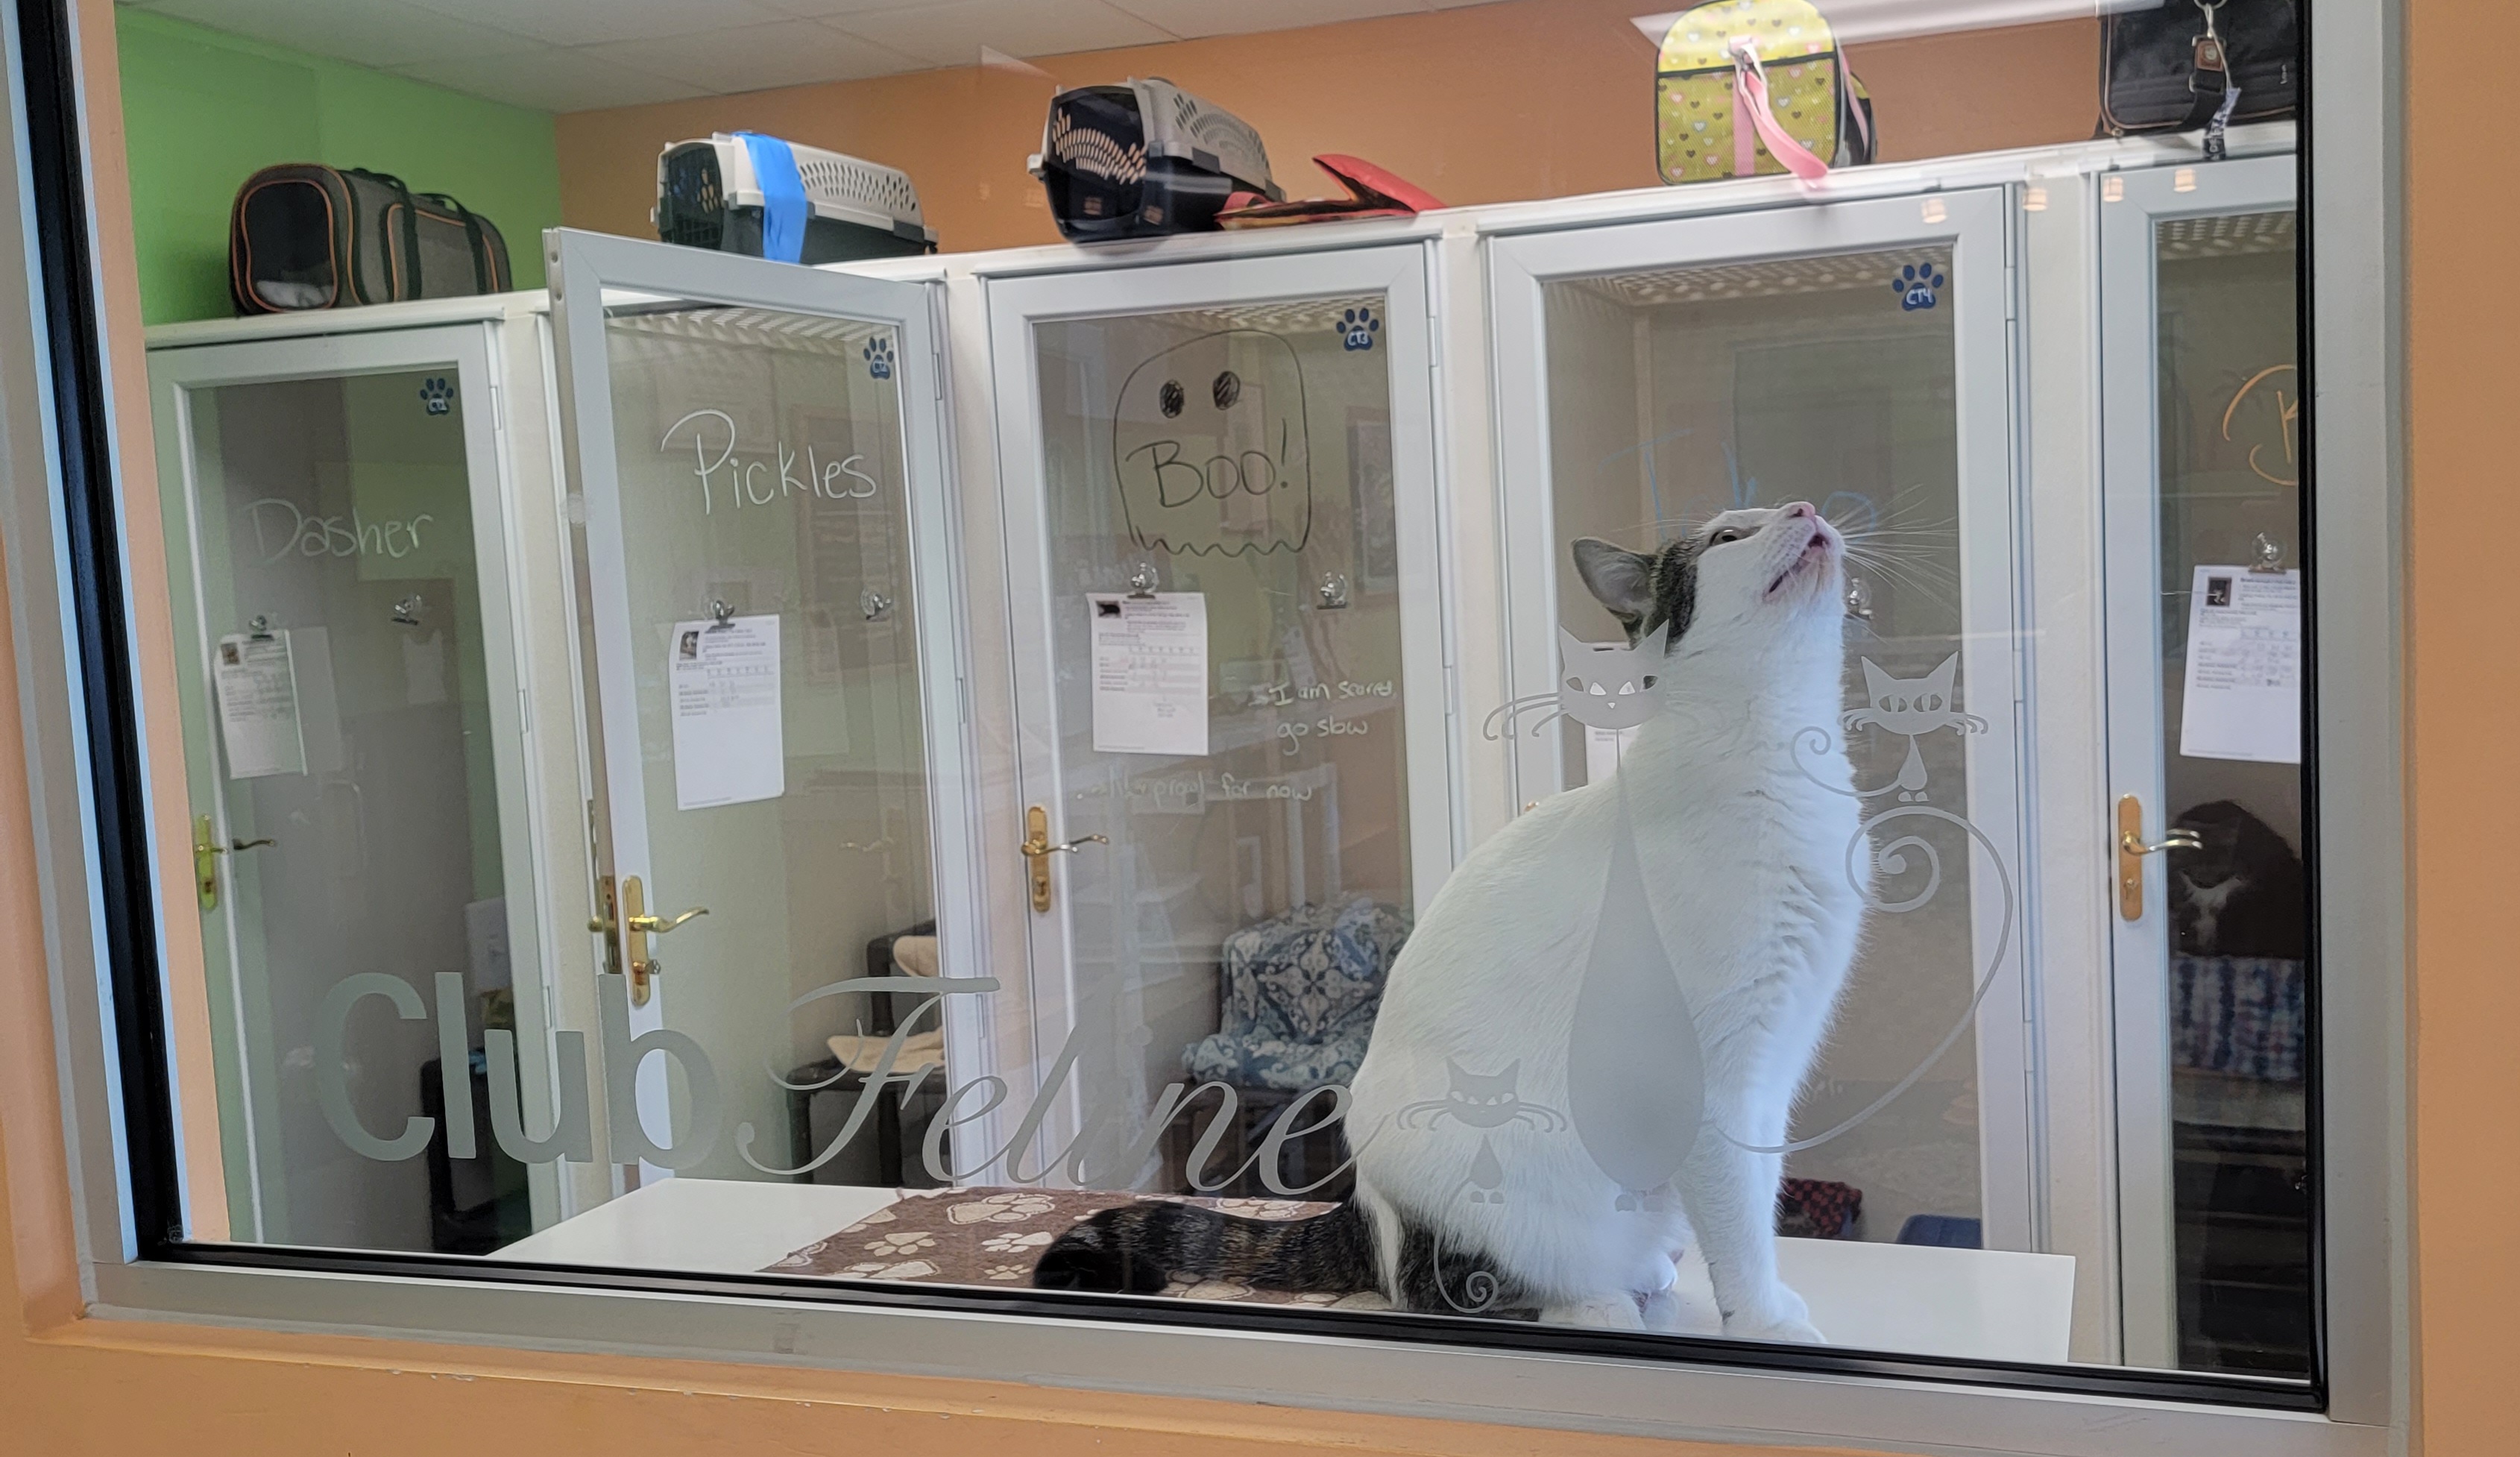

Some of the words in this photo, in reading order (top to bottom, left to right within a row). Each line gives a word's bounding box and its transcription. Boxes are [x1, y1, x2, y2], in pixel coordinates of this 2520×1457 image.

[1906, 287, 1933, 305] CT4
[661, 408, 877, 514] Pickles
[1126, 418, 1289, 508] Boo!
[239, 497, 434, 564] Dasher
[1297, 682, 1331, 701] am
[1276, 721, 1309, 757] go
[1316, 714, 1369, 737] slow
[1221, 772, 1250, 799] for
[1267, 784, 1312, 801] now
[319, 972, 723, 1170] Club
[735, 973, 1388, 1196] Feline
